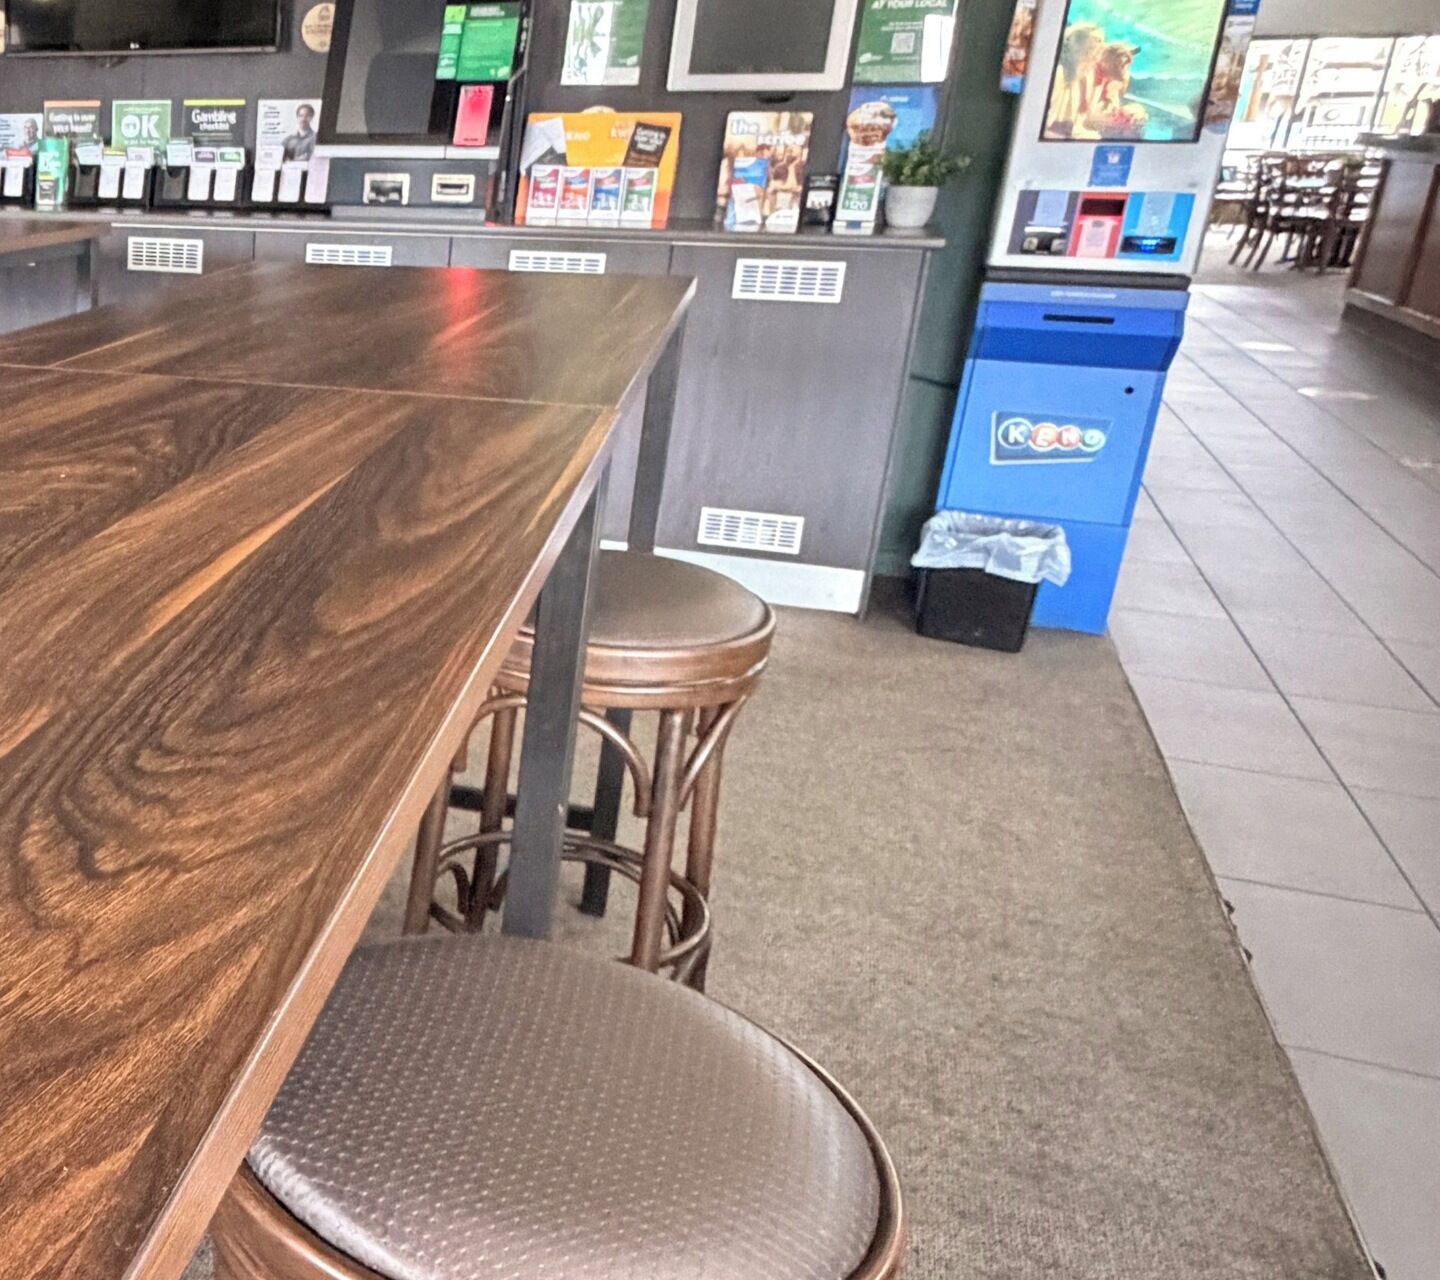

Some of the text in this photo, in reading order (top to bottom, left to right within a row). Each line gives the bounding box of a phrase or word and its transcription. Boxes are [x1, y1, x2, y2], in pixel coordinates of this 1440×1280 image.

[121, 114, 160, 138] OK
[191, 109, 237, 125] Gambling
[732, 119, 760, 135] the
[1004, 421, 1105, 450] KENO
